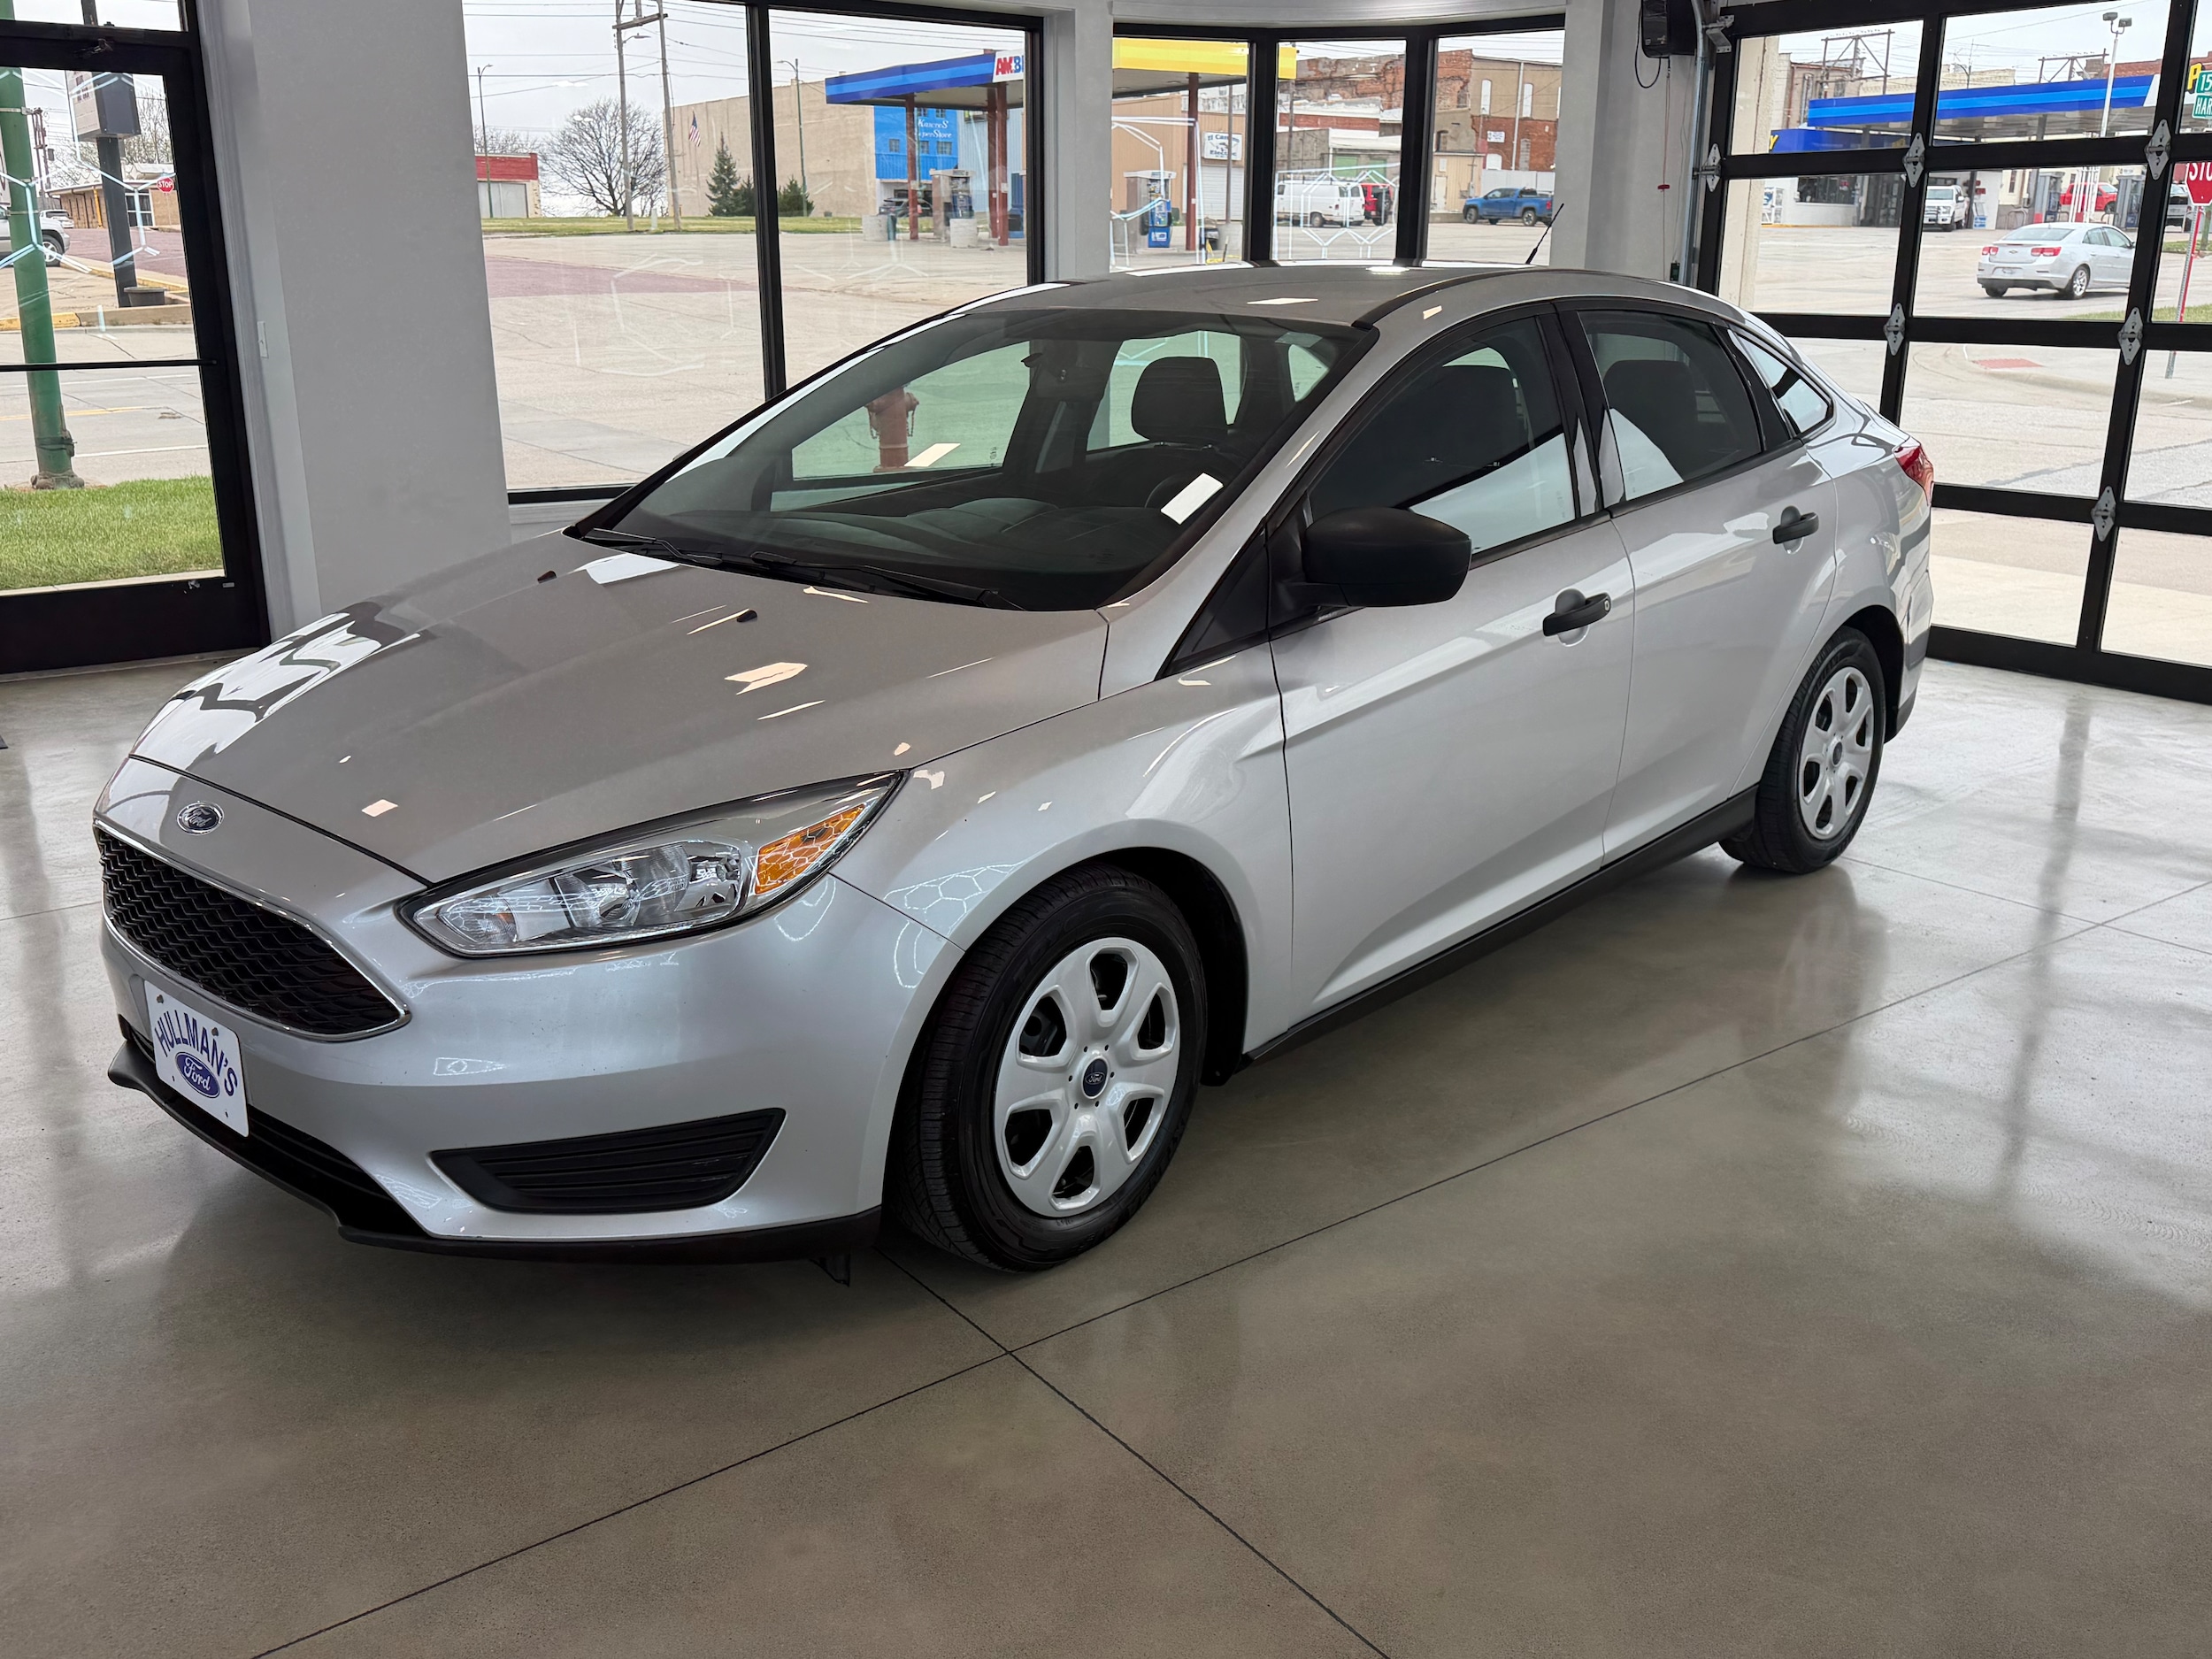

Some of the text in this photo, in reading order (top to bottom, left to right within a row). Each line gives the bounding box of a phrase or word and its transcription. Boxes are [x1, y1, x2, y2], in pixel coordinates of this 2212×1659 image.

[157, 180, 173, 188] STOP
[154, 1010, 238, 1097] HULLMAN'S
[183, 1056, 211, 1091] Ford
